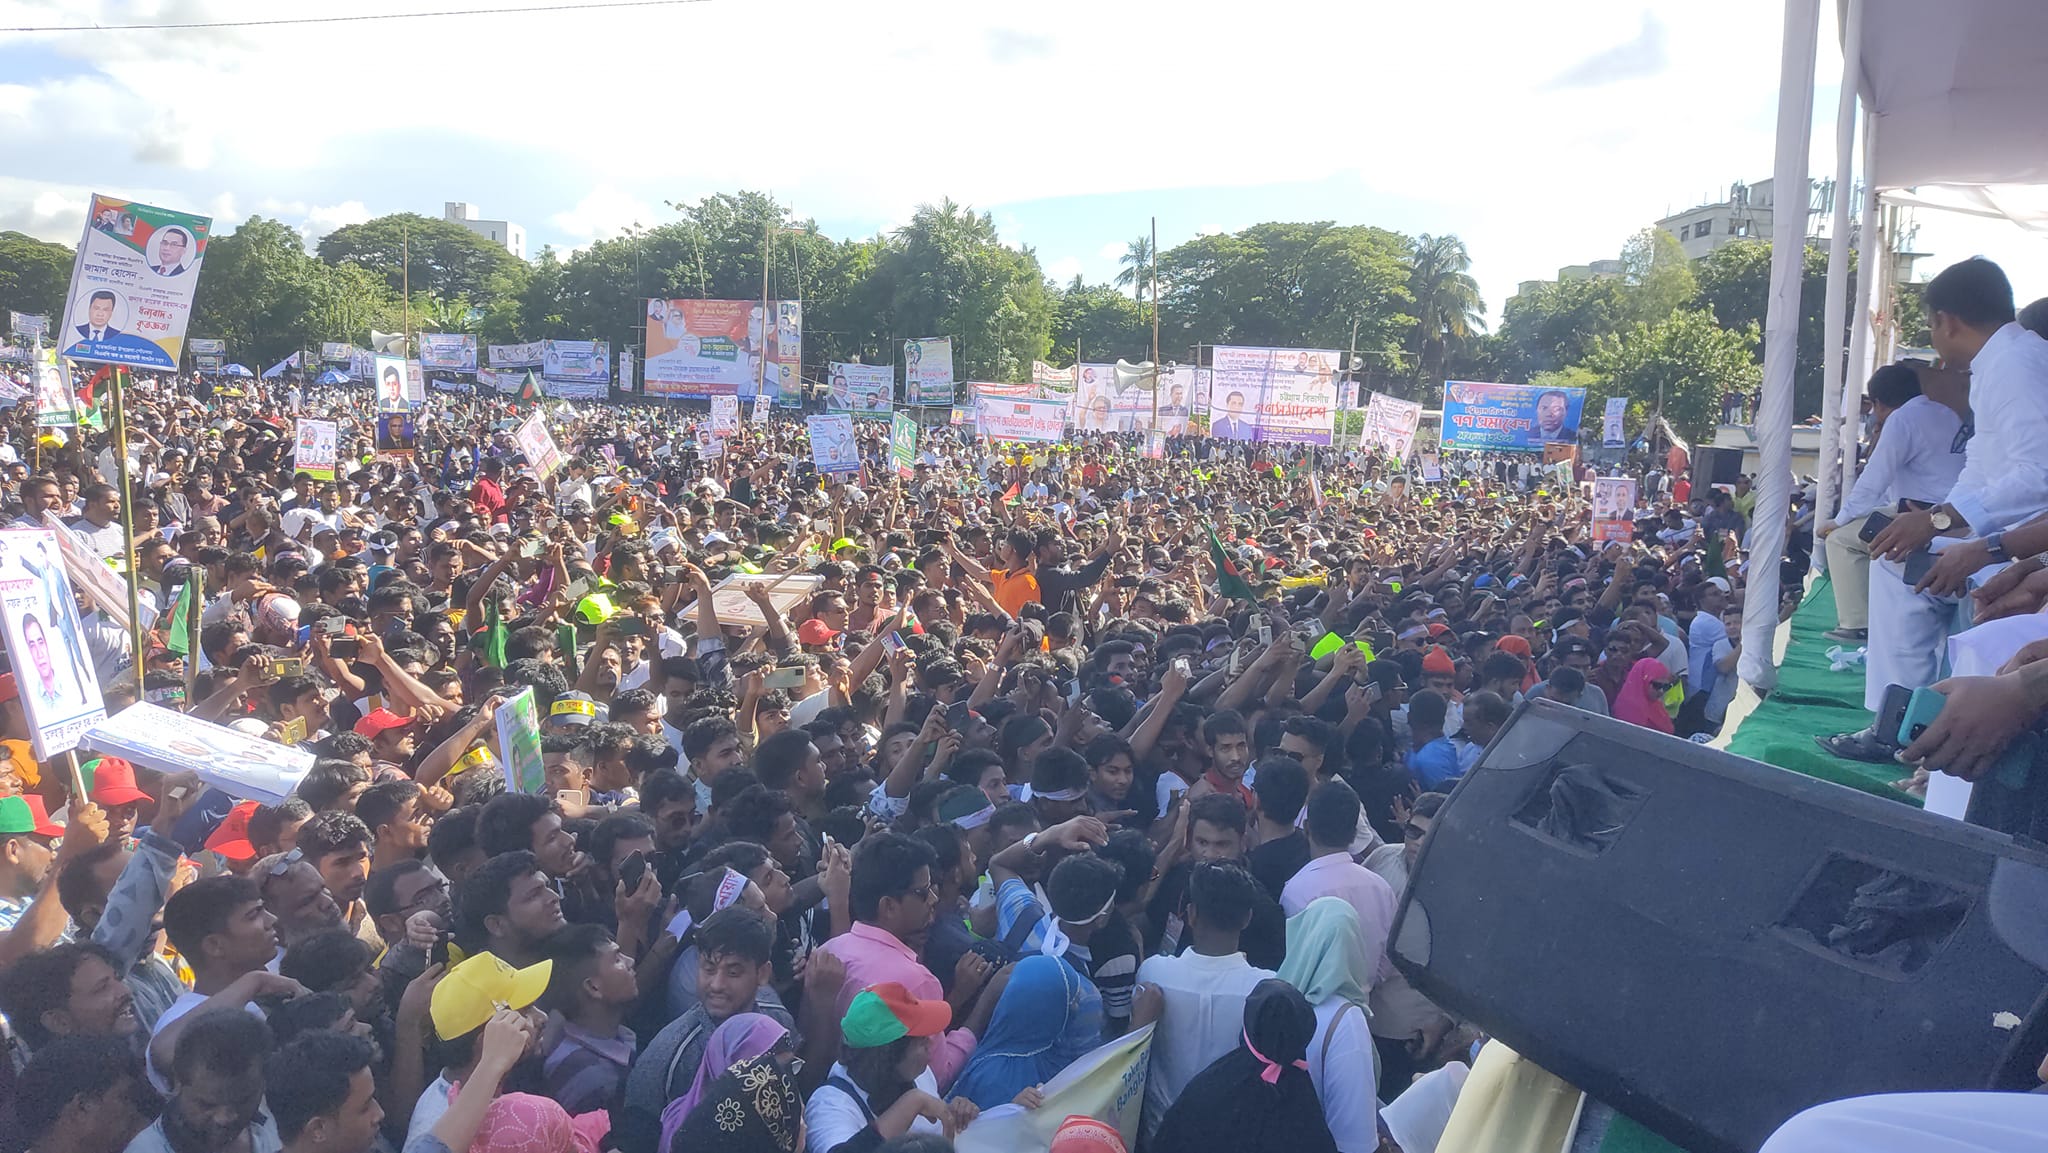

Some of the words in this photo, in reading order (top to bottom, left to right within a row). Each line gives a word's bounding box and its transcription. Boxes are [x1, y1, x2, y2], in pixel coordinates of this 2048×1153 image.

[84, 263, 108, 275] জামাল
[111, 268, 137, 280] হোসেন
[138, 305, 165, 319] ধন্যবাদ
[136, 319, 170, 332] কৃতজ্ঞতা
[1452, 413, 1473, 428] গণ
[1476, 415, 1532, 433] সমাবেশ
[1121, 1061, 1140, 1088] Take
